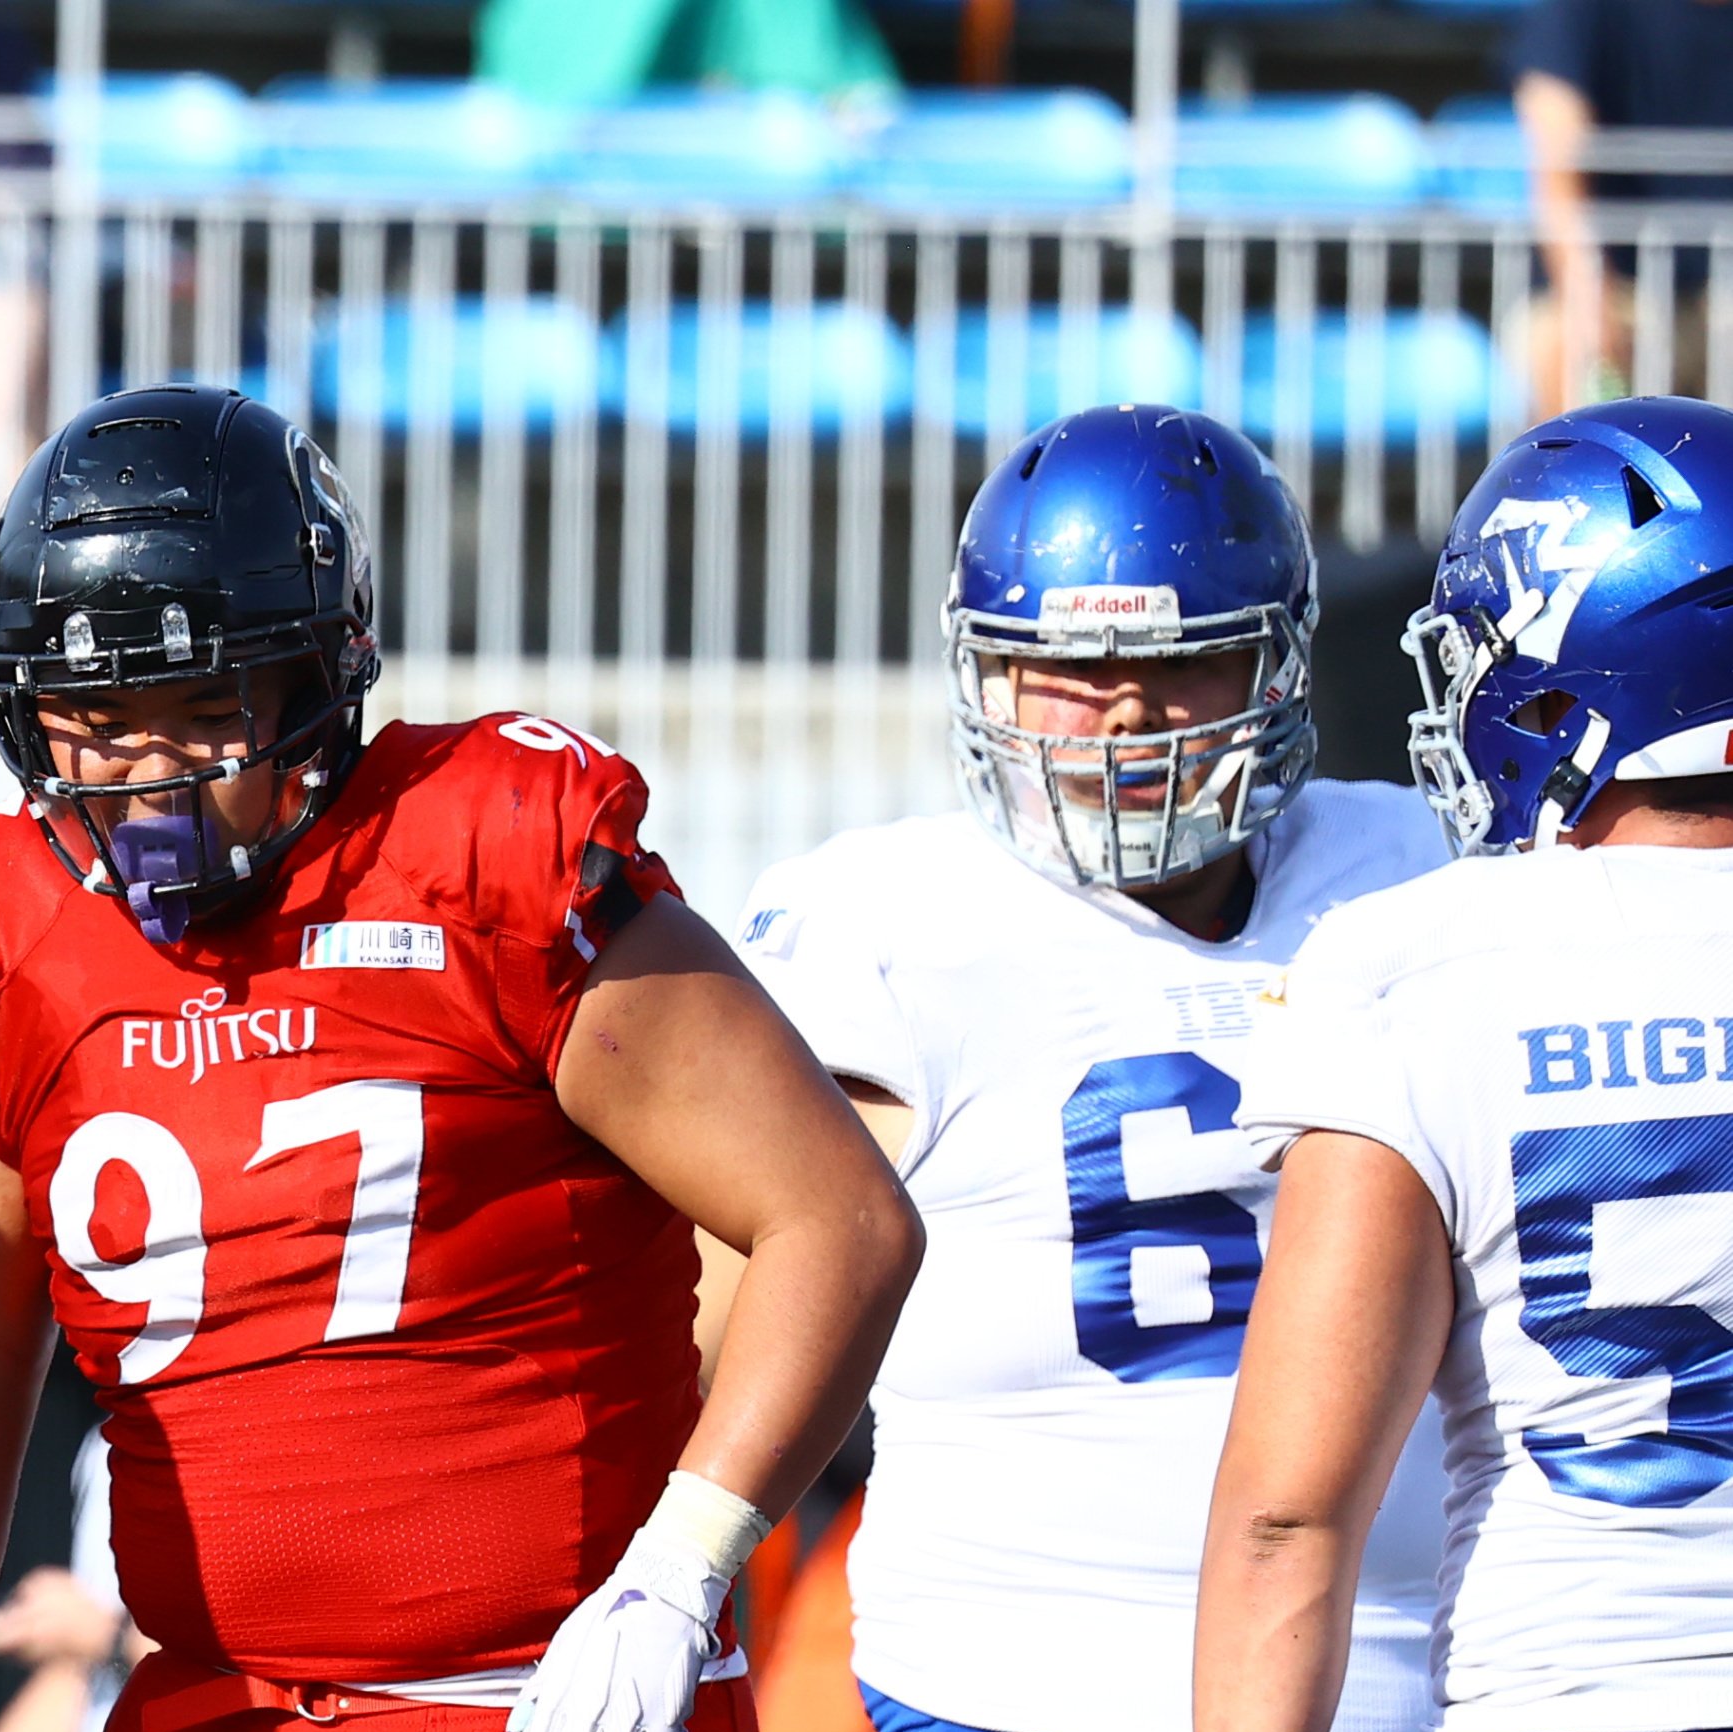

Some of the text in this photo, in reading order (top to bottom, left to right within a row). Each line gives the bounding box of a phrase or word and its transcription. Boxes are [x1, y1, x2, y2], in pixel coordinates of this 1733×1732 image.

[359, 926, 440, 951] 川崎市
[360, 955, 441, 966] KAWASAKI CITY
[122, 988, 317, 1084] FUJITSU
[1517, 1017, 1733, 1095] BIG
[49, 1078, 425, 1385] 97
[1062, 1051, 1263, 1384] 6
[1510, 1112, 1733, 1508] 5
